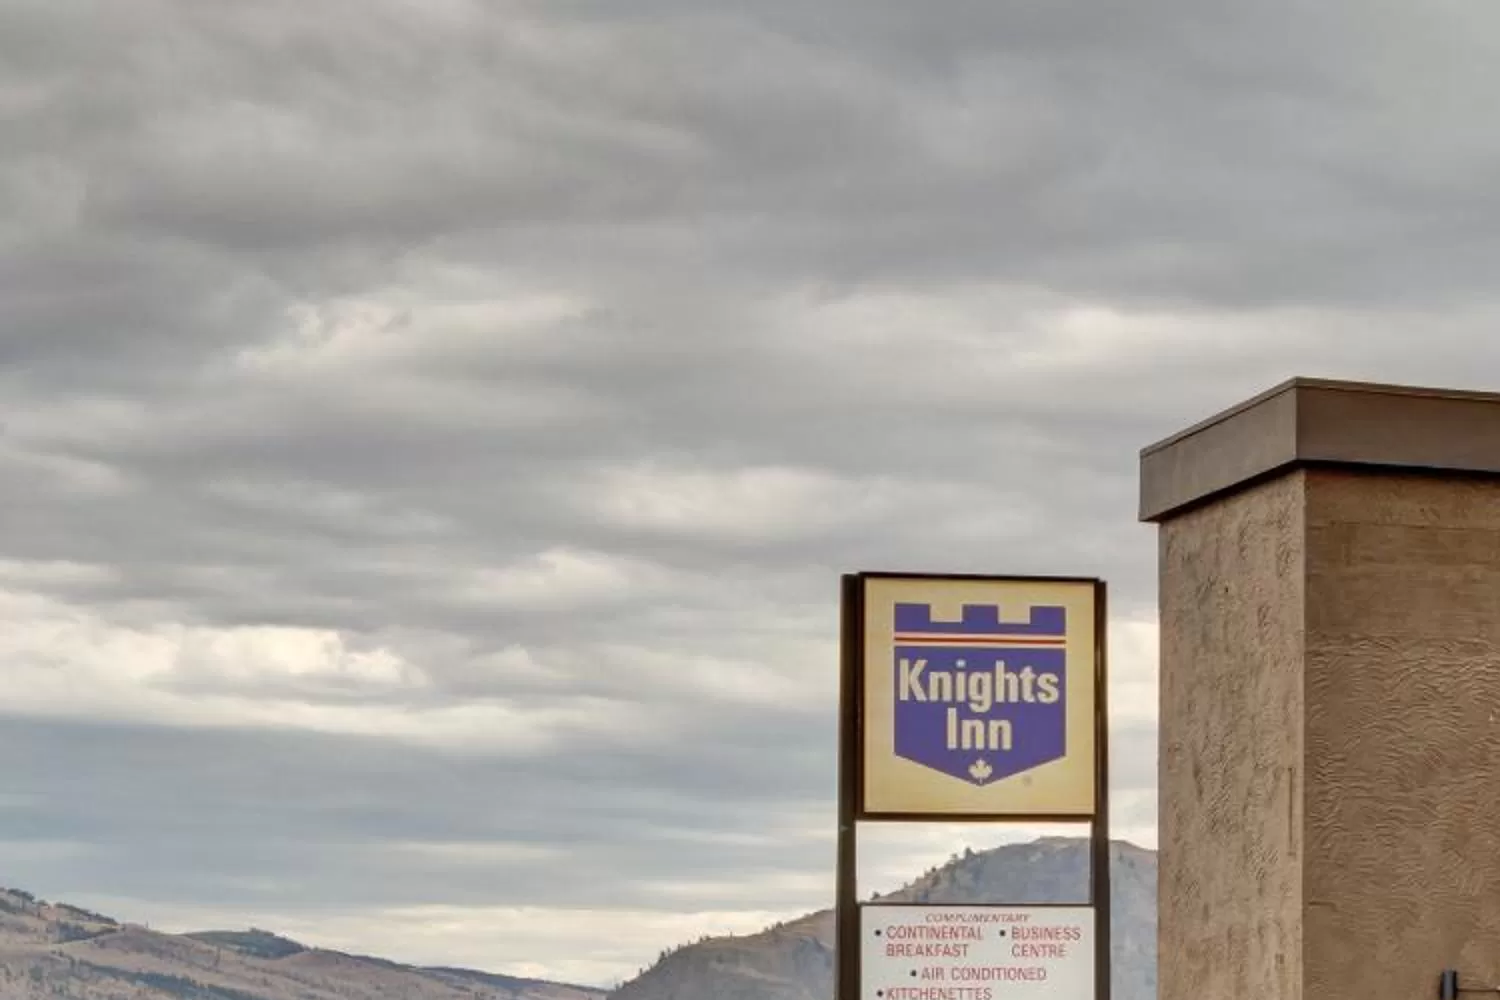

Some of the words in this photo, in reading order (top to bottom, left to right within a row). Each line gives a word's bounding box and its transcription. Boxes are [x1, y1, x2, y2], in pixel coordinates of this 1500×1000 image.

[899, 658, 1060, 713] Knights
[946, 707, 1013, 751] Inn
[925, 913, 1031, 923] COMPLIMENTARY
[886, 925, 984, 940] CONTINENTAL
[1011, 925, 1082, 941] BUSINESS
[885, 943, 969, 957] BREAKFAST
[1011, 943, 1066, 958] CENTRE
[921, 967, 945, 981] AIR
[951, 967, 1047, 981] CONDITIONED
[886, 987, 993, 1000] KITCHENETTES
